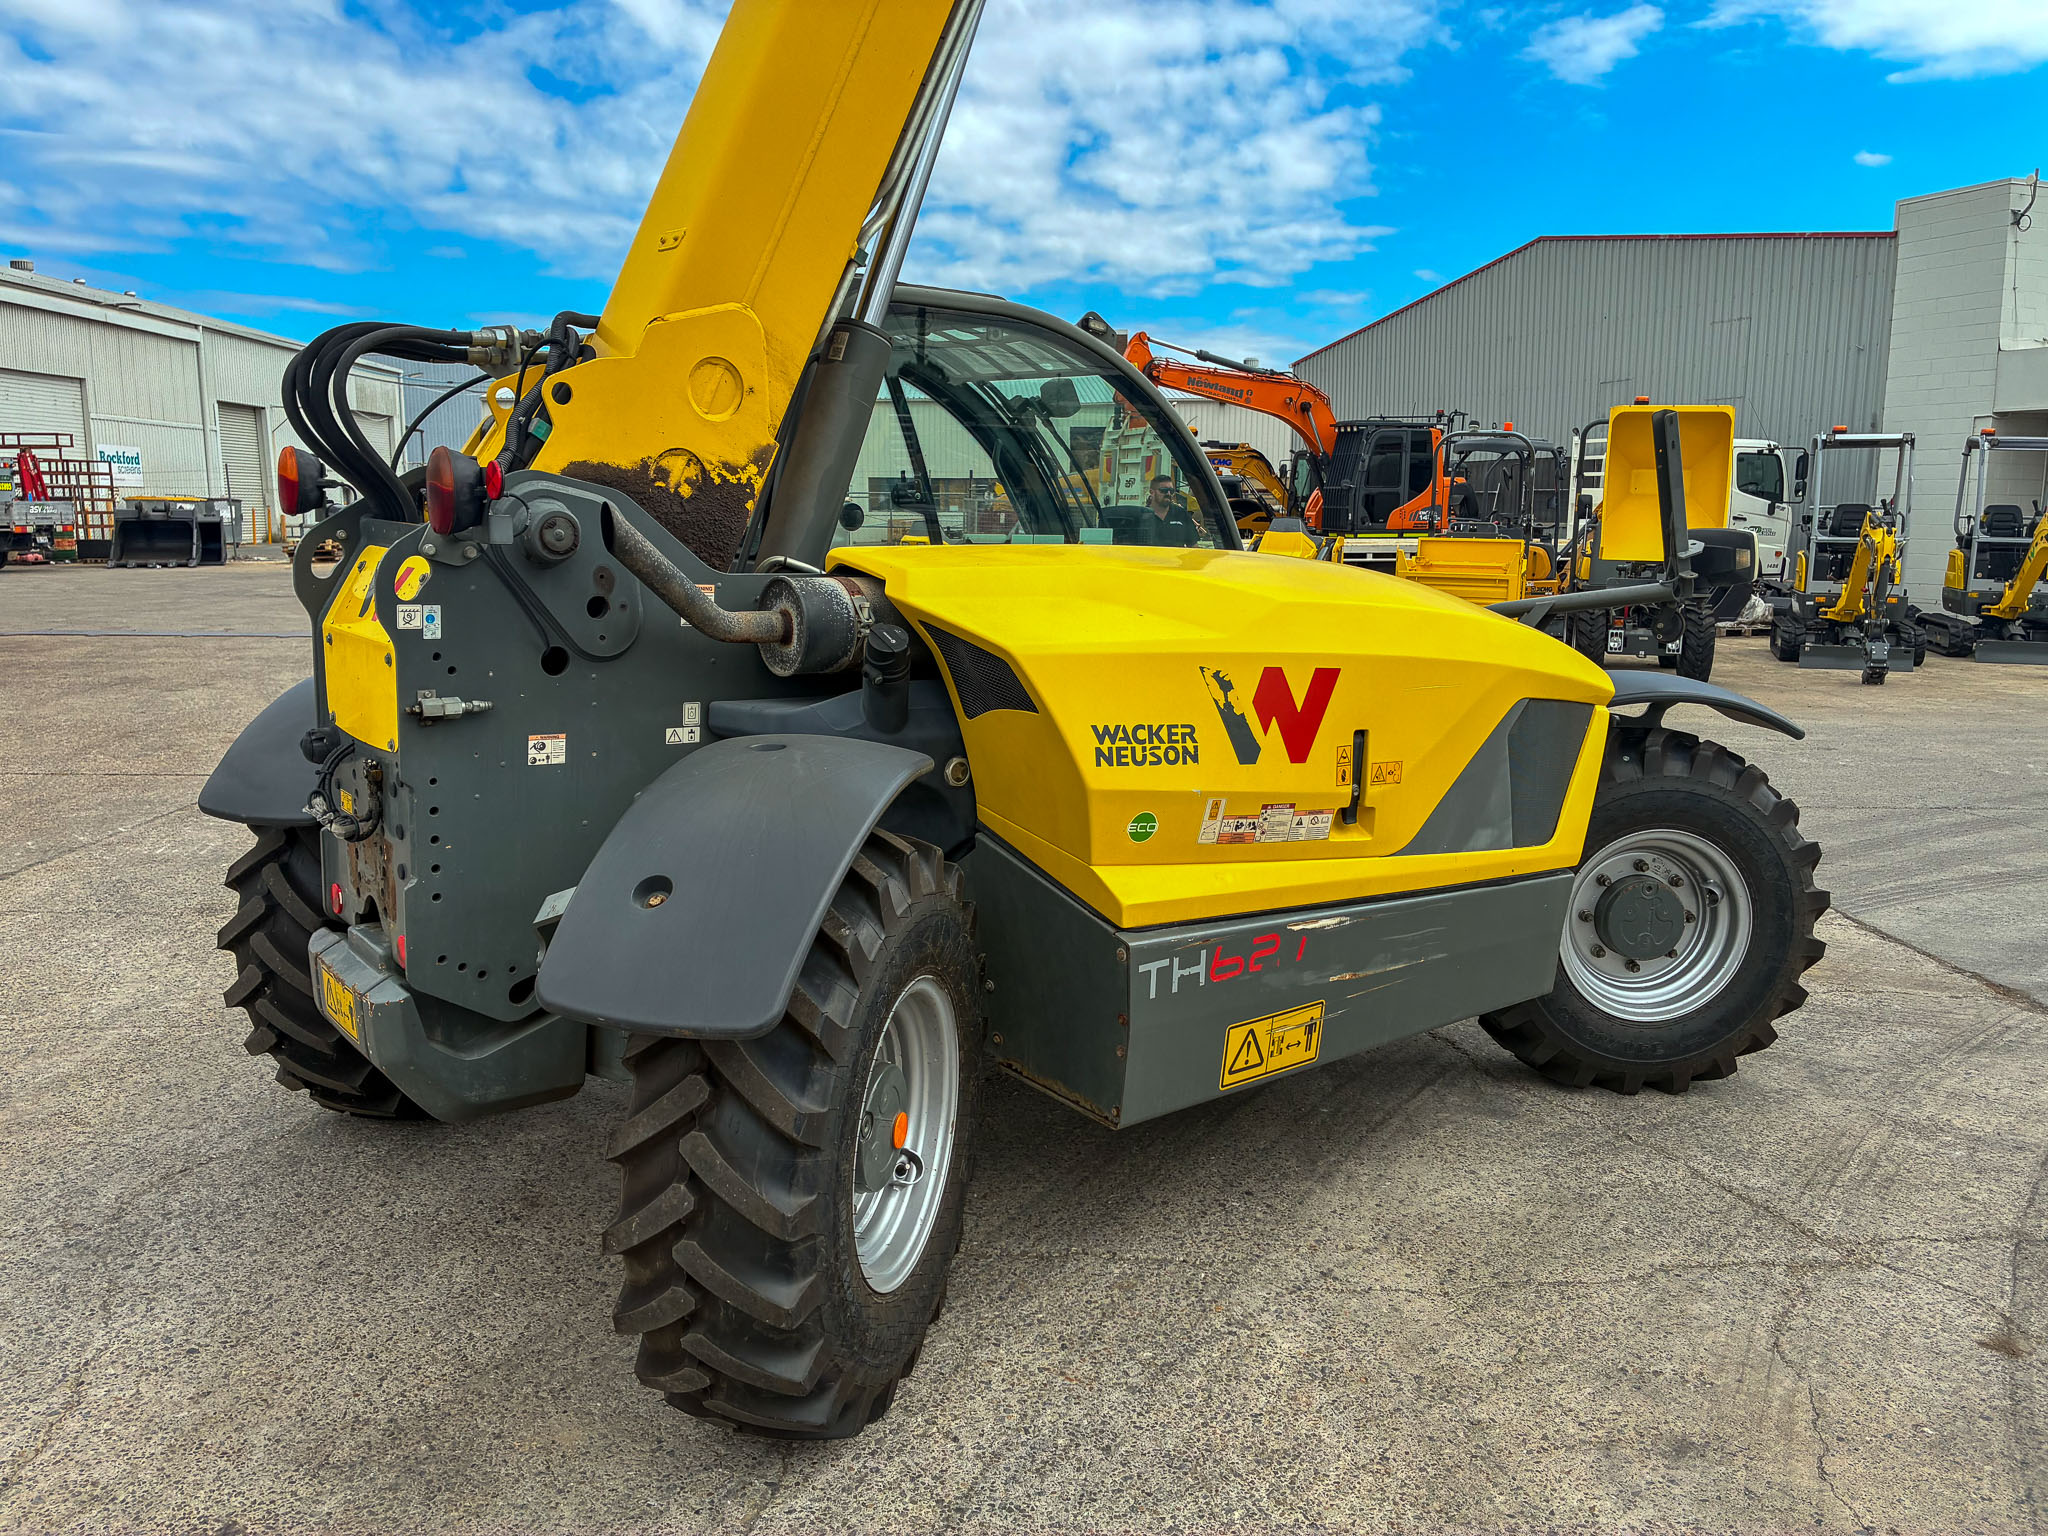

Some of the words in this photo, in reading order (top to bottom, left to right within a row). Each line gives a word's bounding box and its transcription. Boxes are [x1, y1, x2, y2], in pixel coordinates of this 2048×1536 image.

[1187, 376, 1244, 399] Newland
[99, 450, 140, 466] Rockford
[1091, 724, 1198, 745] WACKER
[1094, 745, 1199, 767] NEUSON
[1127, 822, 1158, 833] ECO
